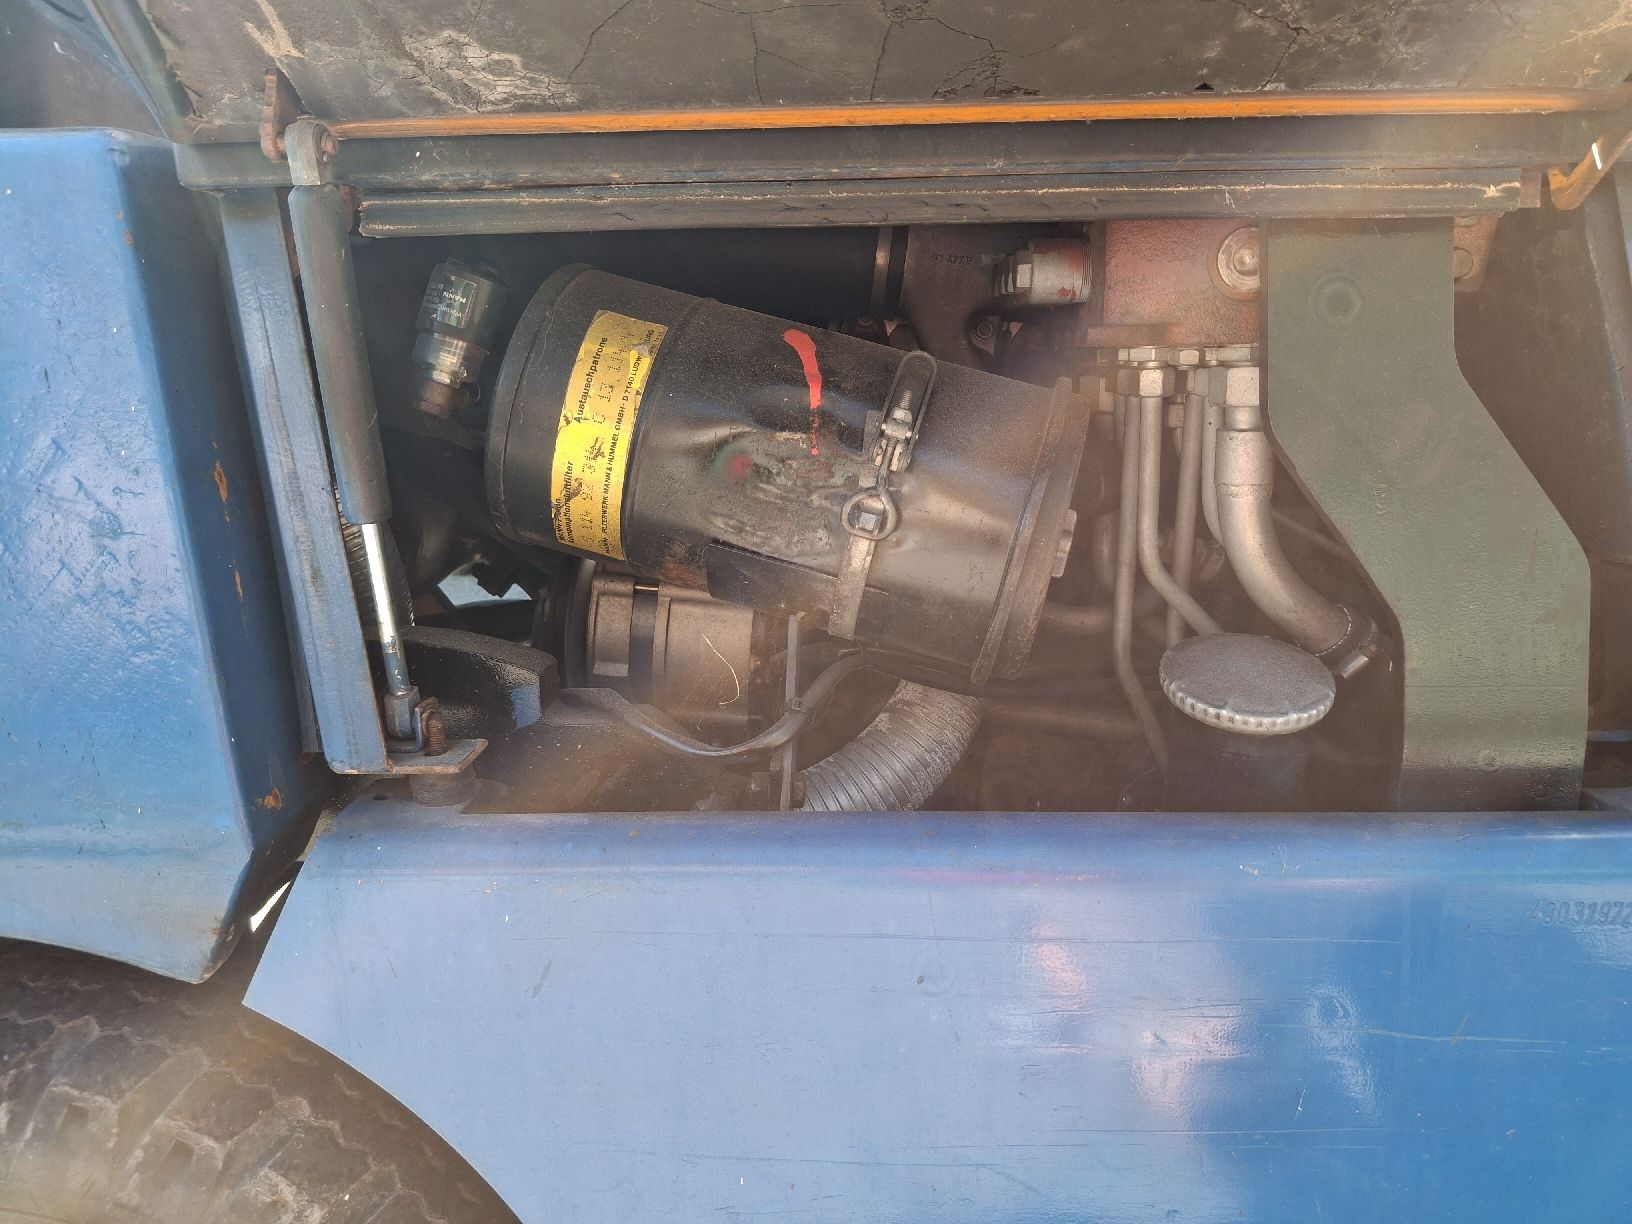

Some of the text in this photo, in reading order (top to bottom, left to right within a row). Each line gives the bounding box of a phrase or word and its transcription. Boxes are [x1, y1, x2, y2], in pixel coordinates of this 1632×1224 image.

[573, 336, 608, 423] Austauschpatrone
[623, 375, 635, 394] 7140
[621, 394, 629, 402] D
[607, 432, 619, 466] HUMMEL
[603, 471, 611, 494] MANN
